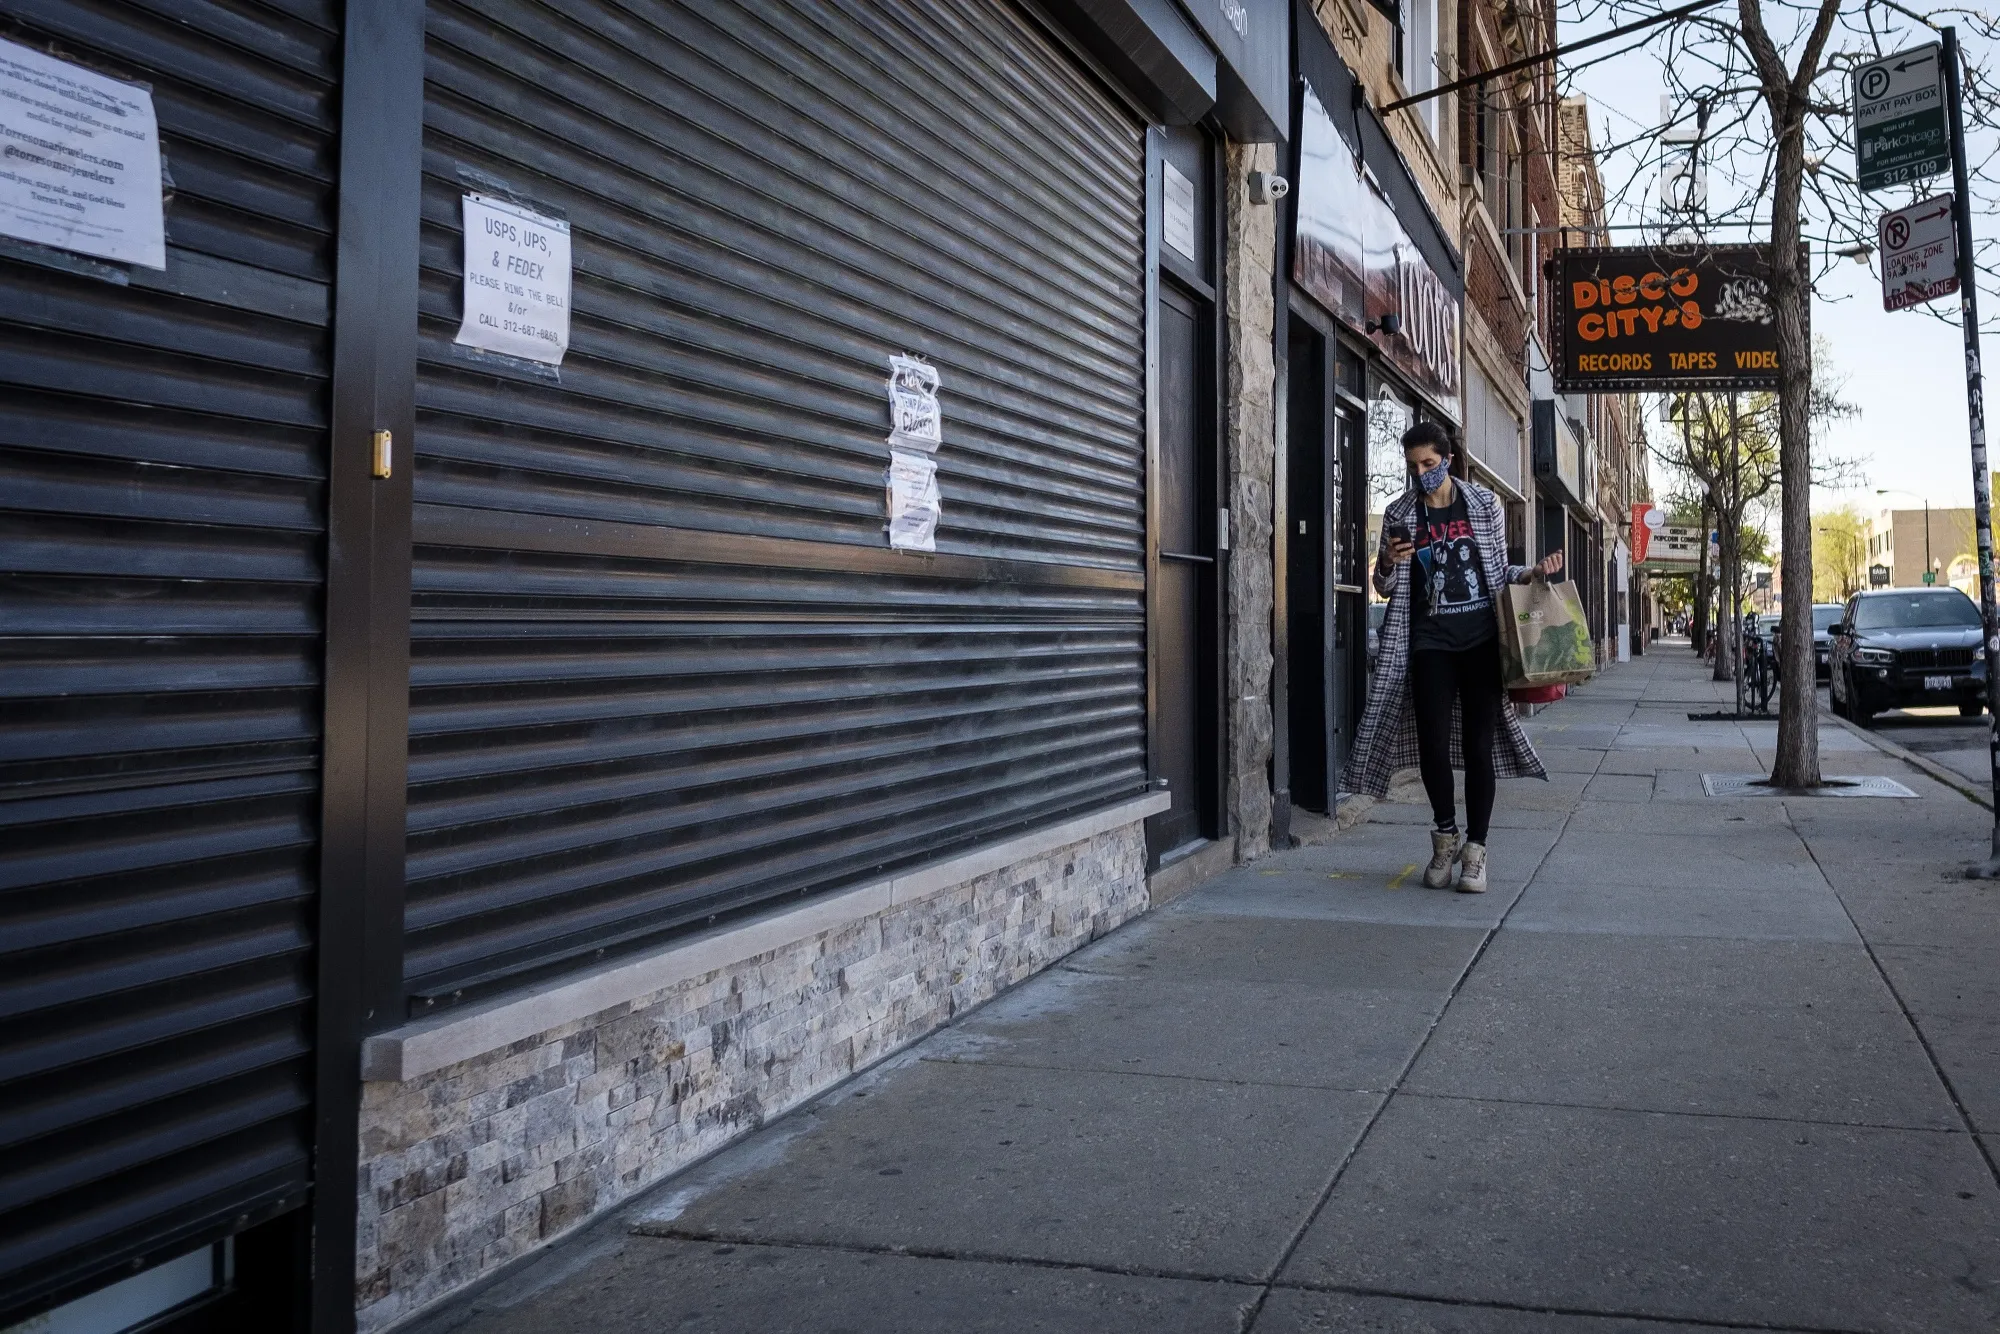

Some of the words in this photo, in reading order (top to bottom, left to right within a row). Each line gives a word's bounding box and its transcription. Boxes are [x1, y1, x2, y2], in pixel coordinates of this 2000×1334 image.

[1859, 105, 1878, 118] PAY
[1880, 101, 1892, 112] AT
[1894, 96, 1912, 108] PAY
[1915, 88, 1937, 102] BOX
[124, 128, 145, 141] social
[1874, 128, 1941, 153] ParkChicago
[1890, 153, 1913, 163] MOBILE
[1884, 167, 1909, 184] 312
[1913, 160, 1938, 177] 109
[492, 250, 500, 268] &
[506, 254, 545, 282] FEDEX
[1886, 251, 1920, 271] LOADING
[1923, 243, 1944, 259] ZONE
[469, 272, 501, 291] PLEASE
[504, 284, 525, 297] RING
[528, 288, 543, 302] THE
[546, 292, 564, 308] BELL
[1926, 279, 1953, 299] ONE
[507, 302, 528, 316] &/or
[479, 313, 499, 329] CALL
[1578, 352, 1652, 372] RECORDS
[1669, 351, 1717, 371] TAPES
